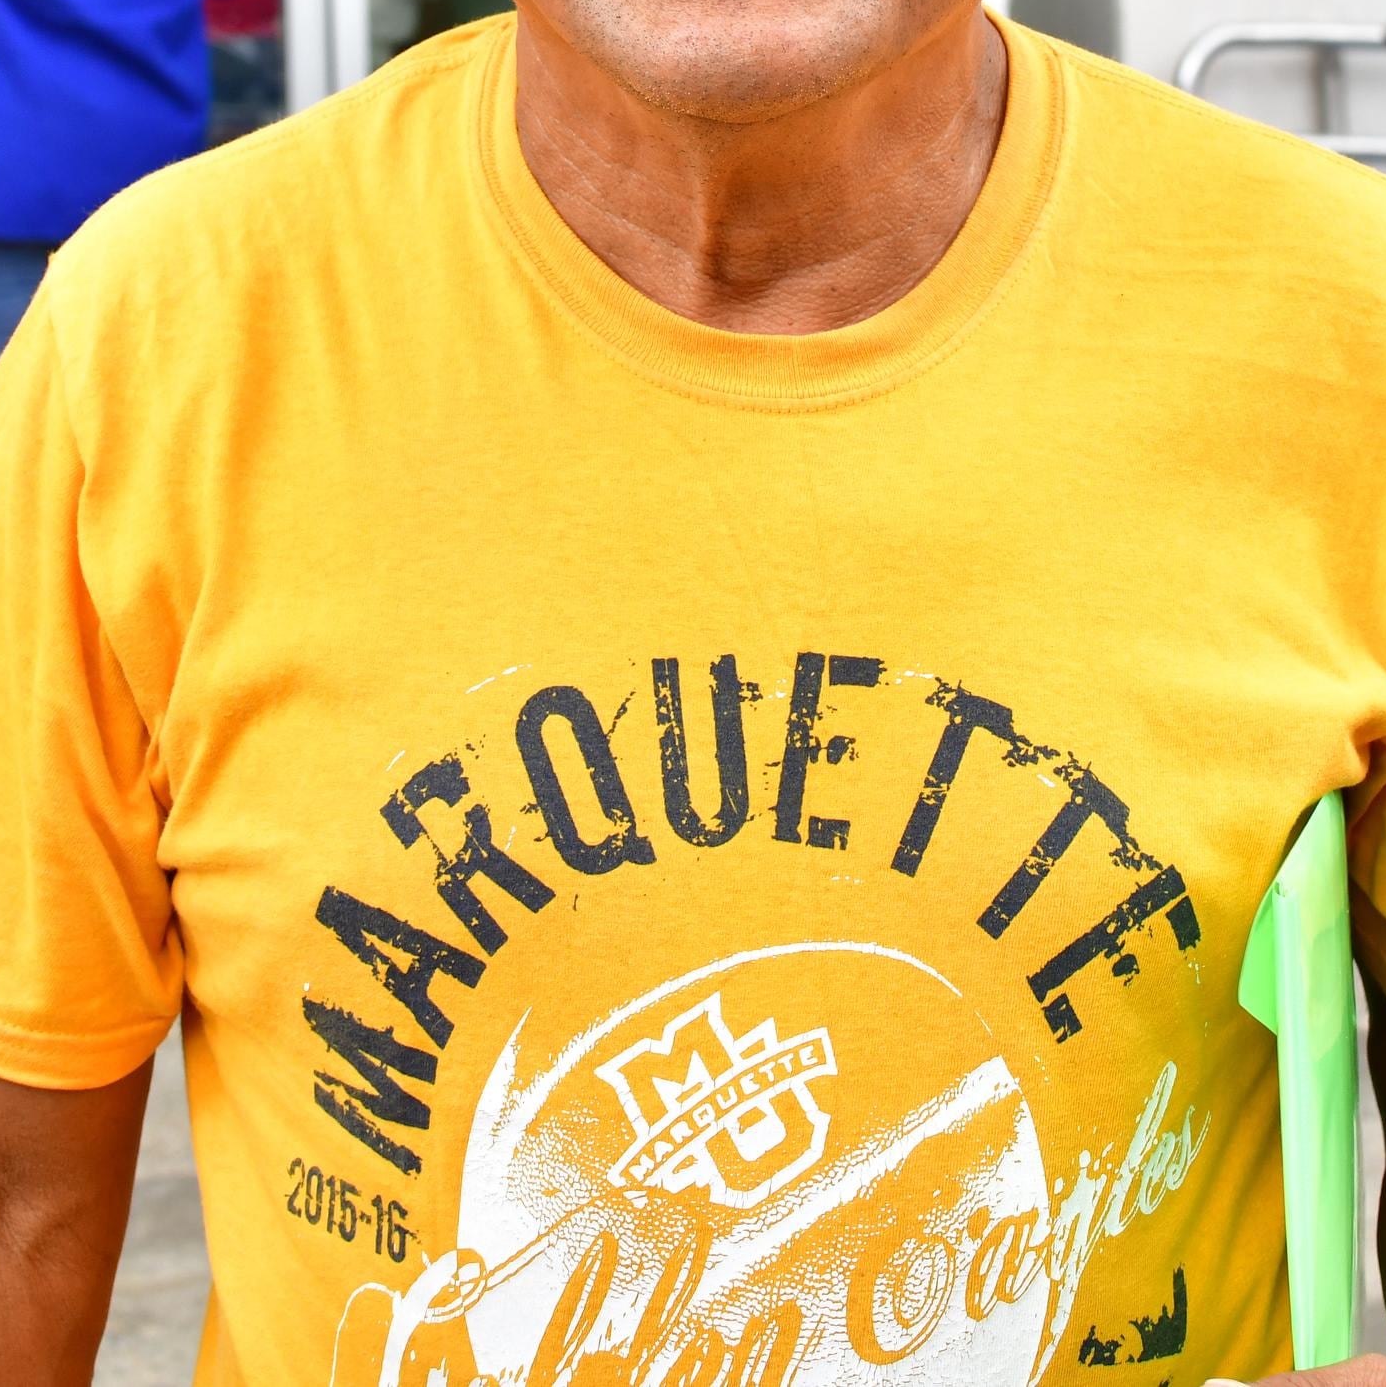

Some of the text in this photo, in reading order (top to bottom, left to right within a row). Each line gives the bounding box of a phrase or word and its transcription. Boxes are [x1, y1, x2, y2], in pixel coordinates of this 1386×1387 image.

[303, 654, 1205, 1177] MARQUETTE
[629, 1045, 818, 1183] MARQUETTE
[286, 1157, 412, 1263] 2015-16
